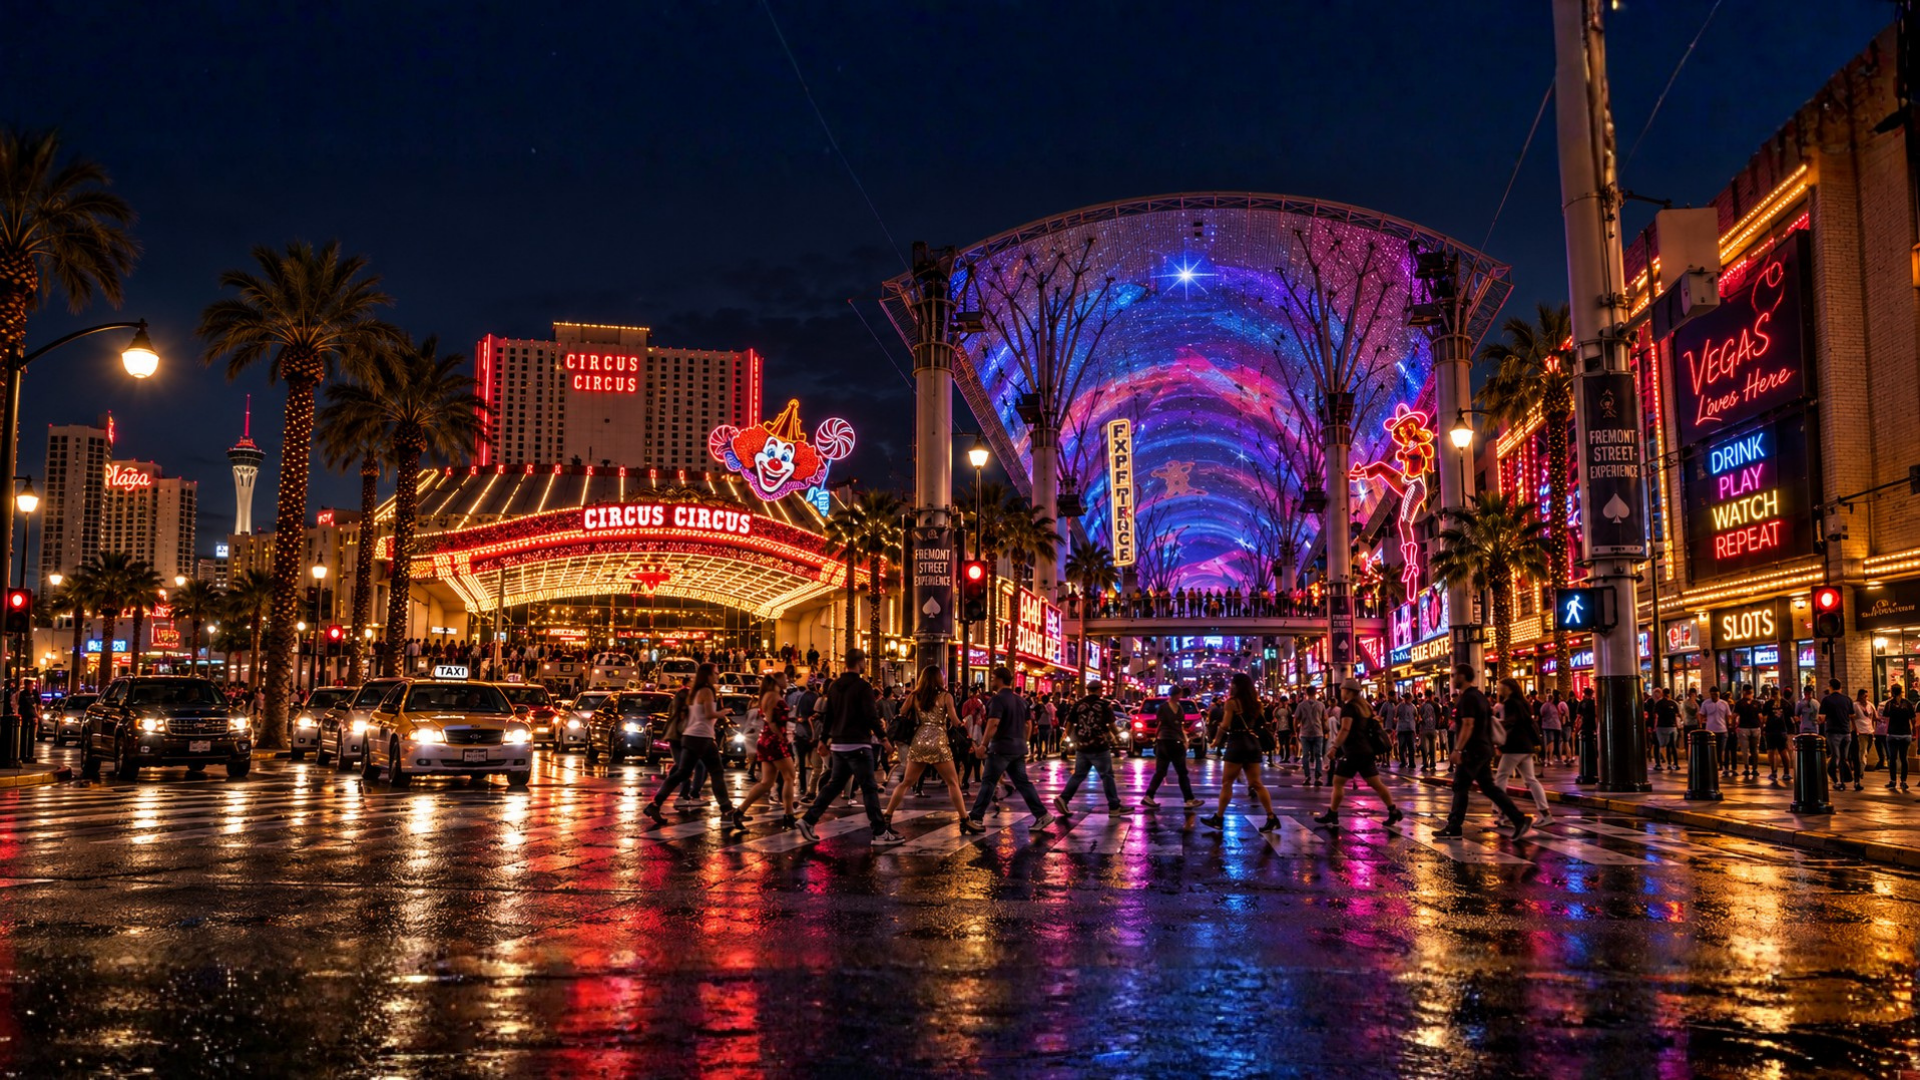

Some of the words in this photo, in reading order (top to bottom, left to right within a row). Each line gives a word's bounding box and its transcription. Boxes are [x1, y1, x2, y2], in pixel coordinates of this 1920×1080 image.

[566, 353, 638, 372] CIRCUS
[1683, 312, 1771, 396] VEGAS
[574, 375, 636, 392] CIRCUS
[1694, 390, 1739, 426] Loves
[1743, 368, 1791, 402] Here
[1589, 429, 1635, 445] FREMONT
[1711, 432, 1765, 474] DRINK
[1590, 464, 1638, 479] EXPERIENCE
[1719, 463, 1763, 500] PLAY
[584, 505, 664, 529] CIRCUS
[674, 506, 751, 534] CIRCUS
[1712, 489, 1779, 531] WATCH
[1716, 520, 1780, 559] REPEAT
[915, 549, 950, 560] FREMONT
[919, 561, 948, 574] STREET
[914, 575, 950, 587] EXPERIENCE
[1723, 609, 1774, 641] SLOTS
[440, 666, 465, 676] TAXI
